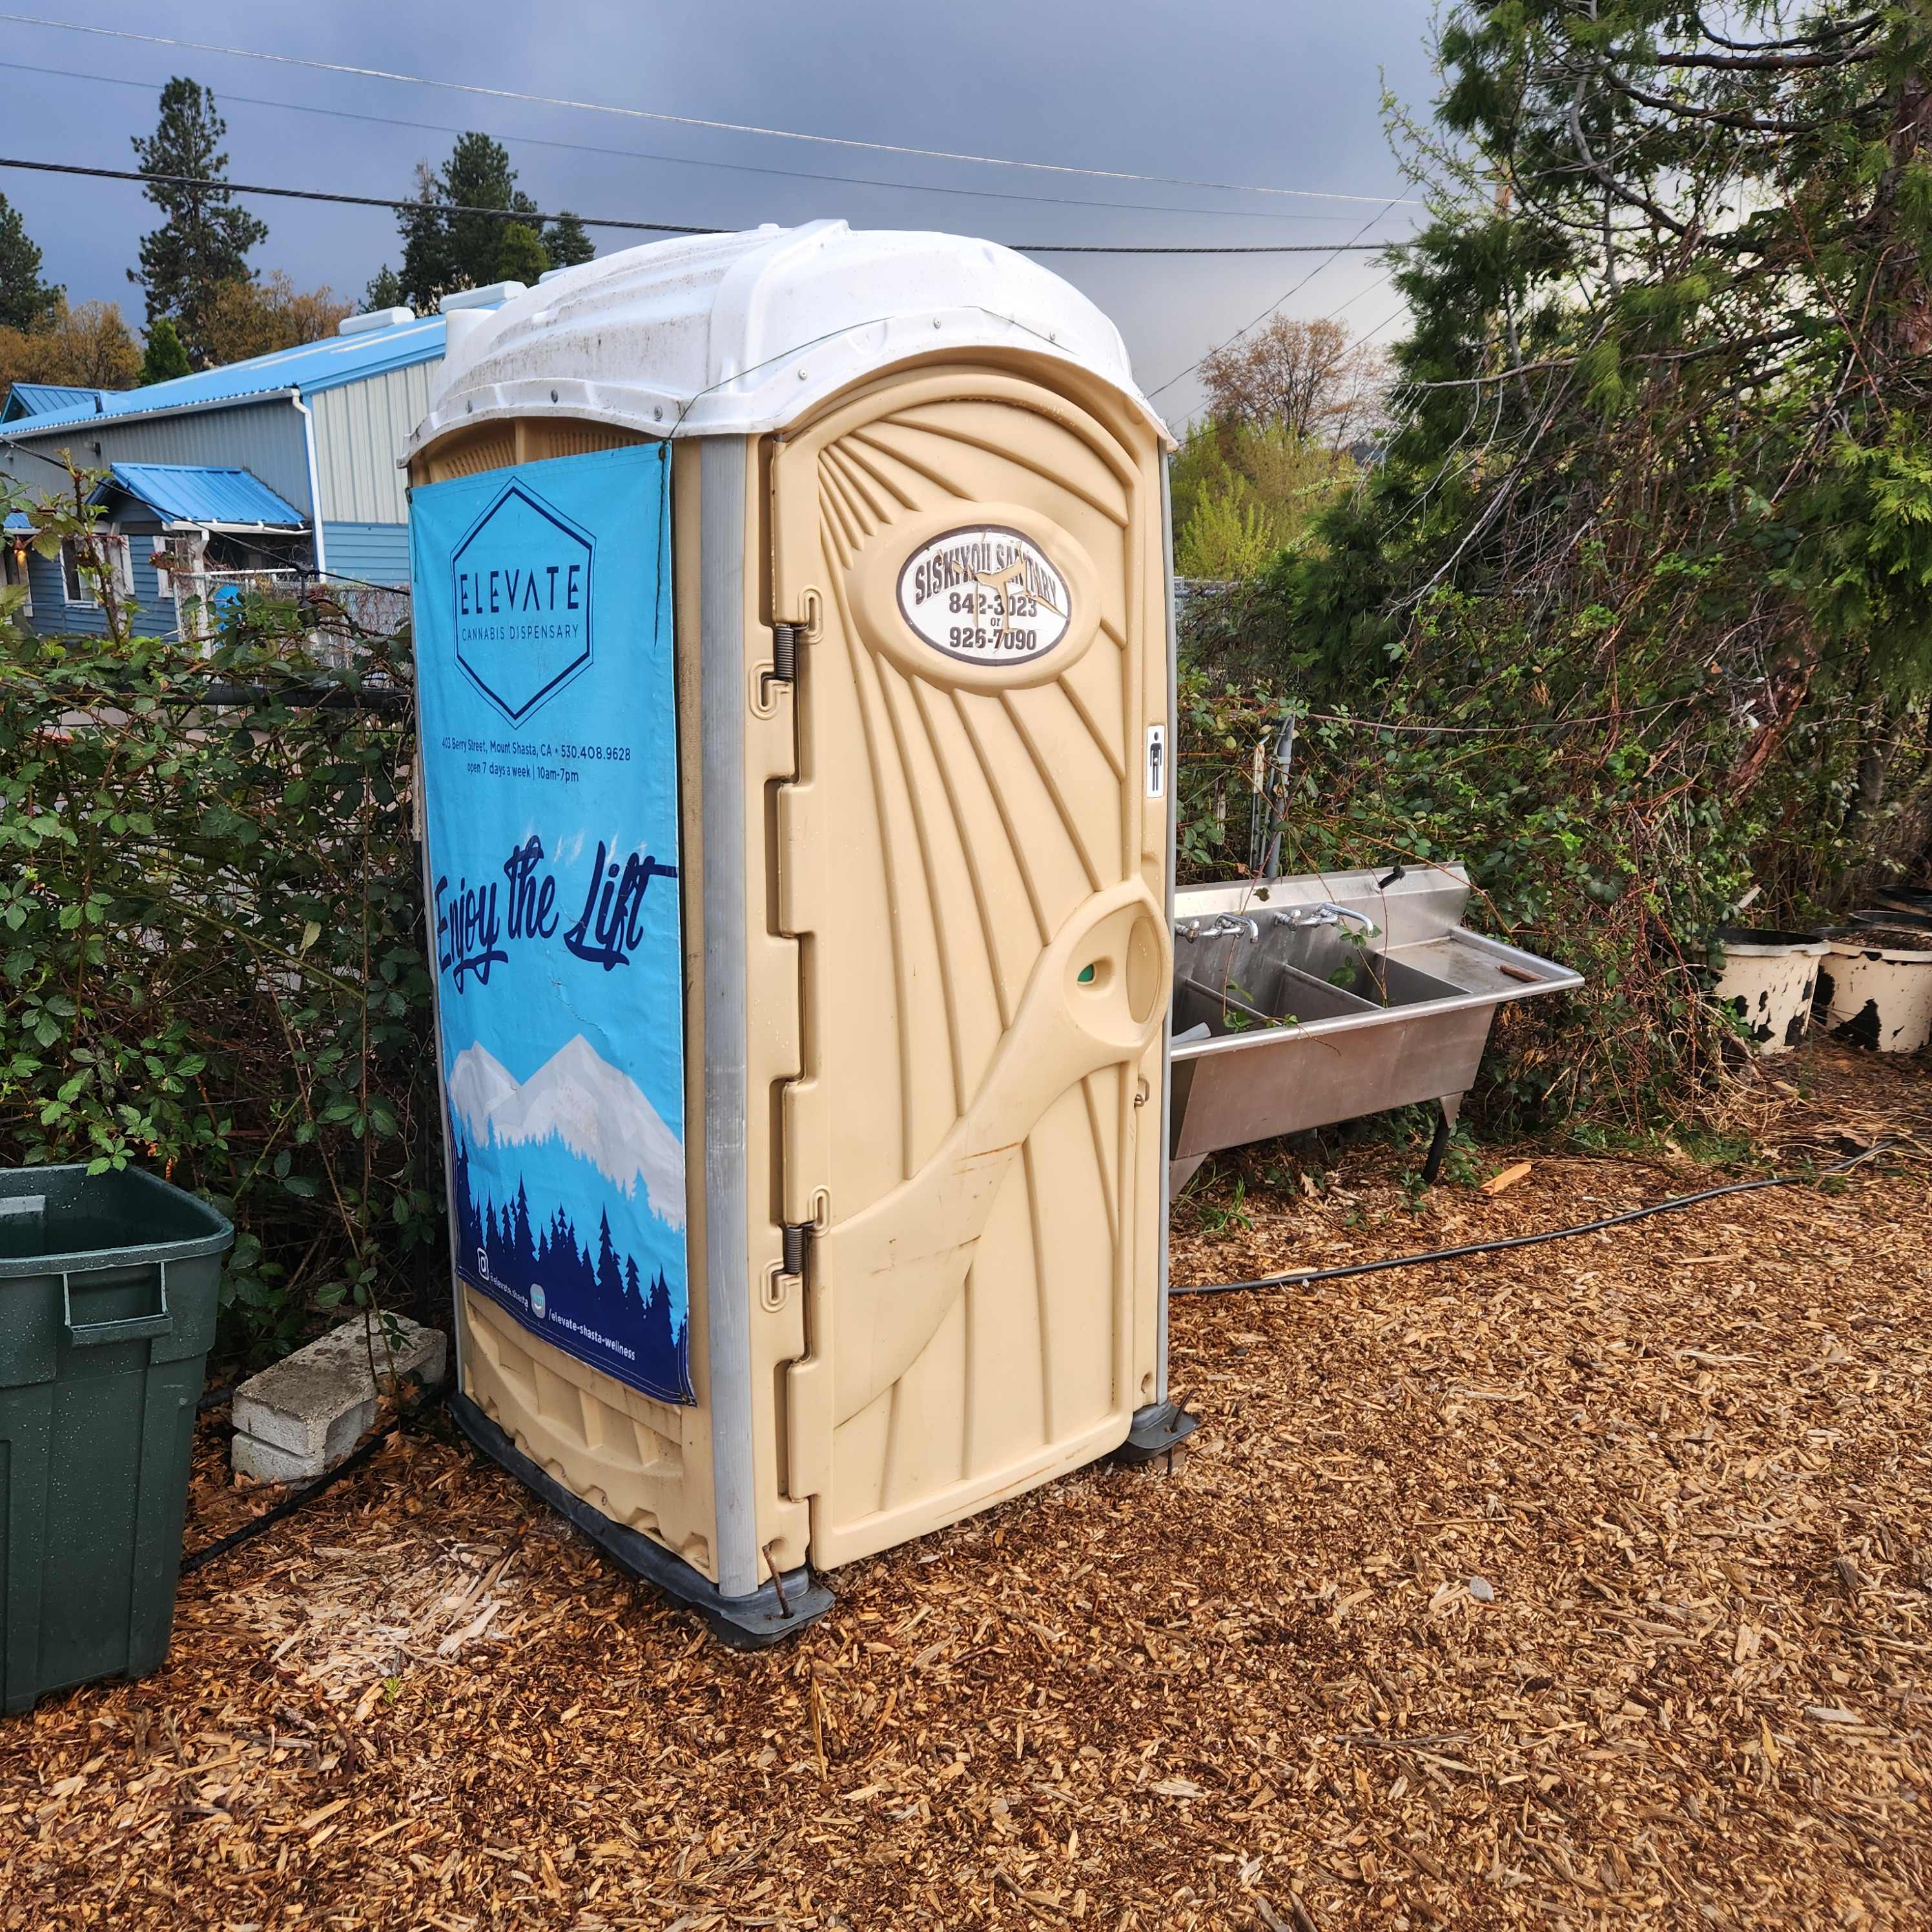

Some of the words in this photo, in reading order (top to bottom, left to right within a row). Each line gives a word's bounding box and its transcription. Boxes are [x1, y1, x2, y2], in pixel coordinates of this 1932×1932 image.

[460, 564, 581, 615] ELEVATE
[949, 591, 1037, 617] 842-3023
[462, 626, 505, 642] CANNABIS
[510, 624, 579, 640] DISPENSARY
[990, 617, 1001, 627] or
[949, 626, 1037, 651] 926-7090
[442, 737, 451, 750] 403
[452, 737, 466, 754] Berry
[468, 739, 488, 754] Street,
[490, 740, 511, 754] Mount
[513, 741, 539, 758] Shasta,
[540, 744, 552, 757] CA
[561, 745, 631, 761] 530.408.9628
[468, 763, 481, 775] open
[482, 761, 487, 774] 7
[489, 763, 506, 777] days
[506, 766, 511, 776] a
[512, 765, 531, 778] week
[537, 766, 579, 784] 10am-7pm
[435, 875, 509, 995] Enjoy
[504, 835, 559, 940] the
[563, 840, 679, 972] Lift
